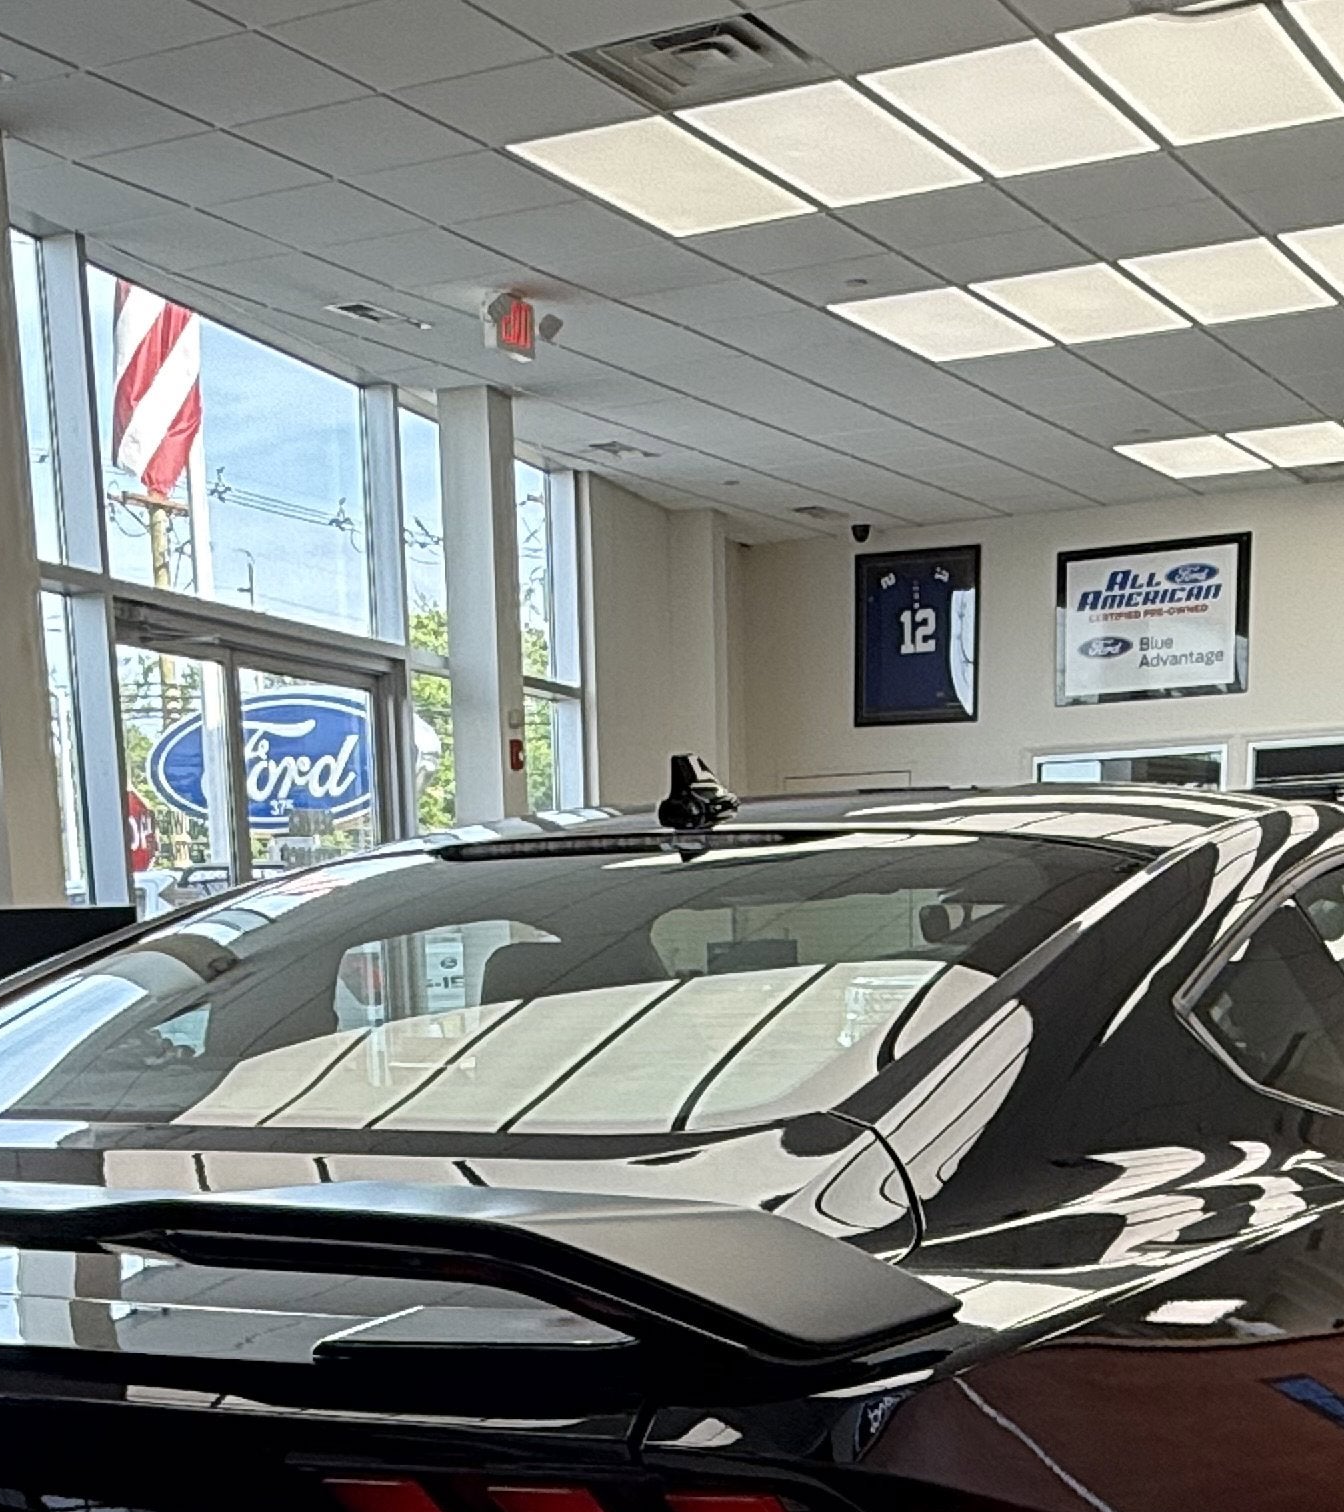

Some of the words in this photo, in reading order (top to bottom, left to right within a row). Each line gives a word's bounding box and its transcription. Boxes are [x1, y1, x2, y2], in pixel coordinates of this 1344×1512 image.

[1077, 584, 1223, 611] AMERICAN
[900, 608, 936, 655] 12
[1139, 636, 1174, 651] Blue
[1139, 650, 1225, 668] Advantage
[201, 719, 359, 801] Ford
